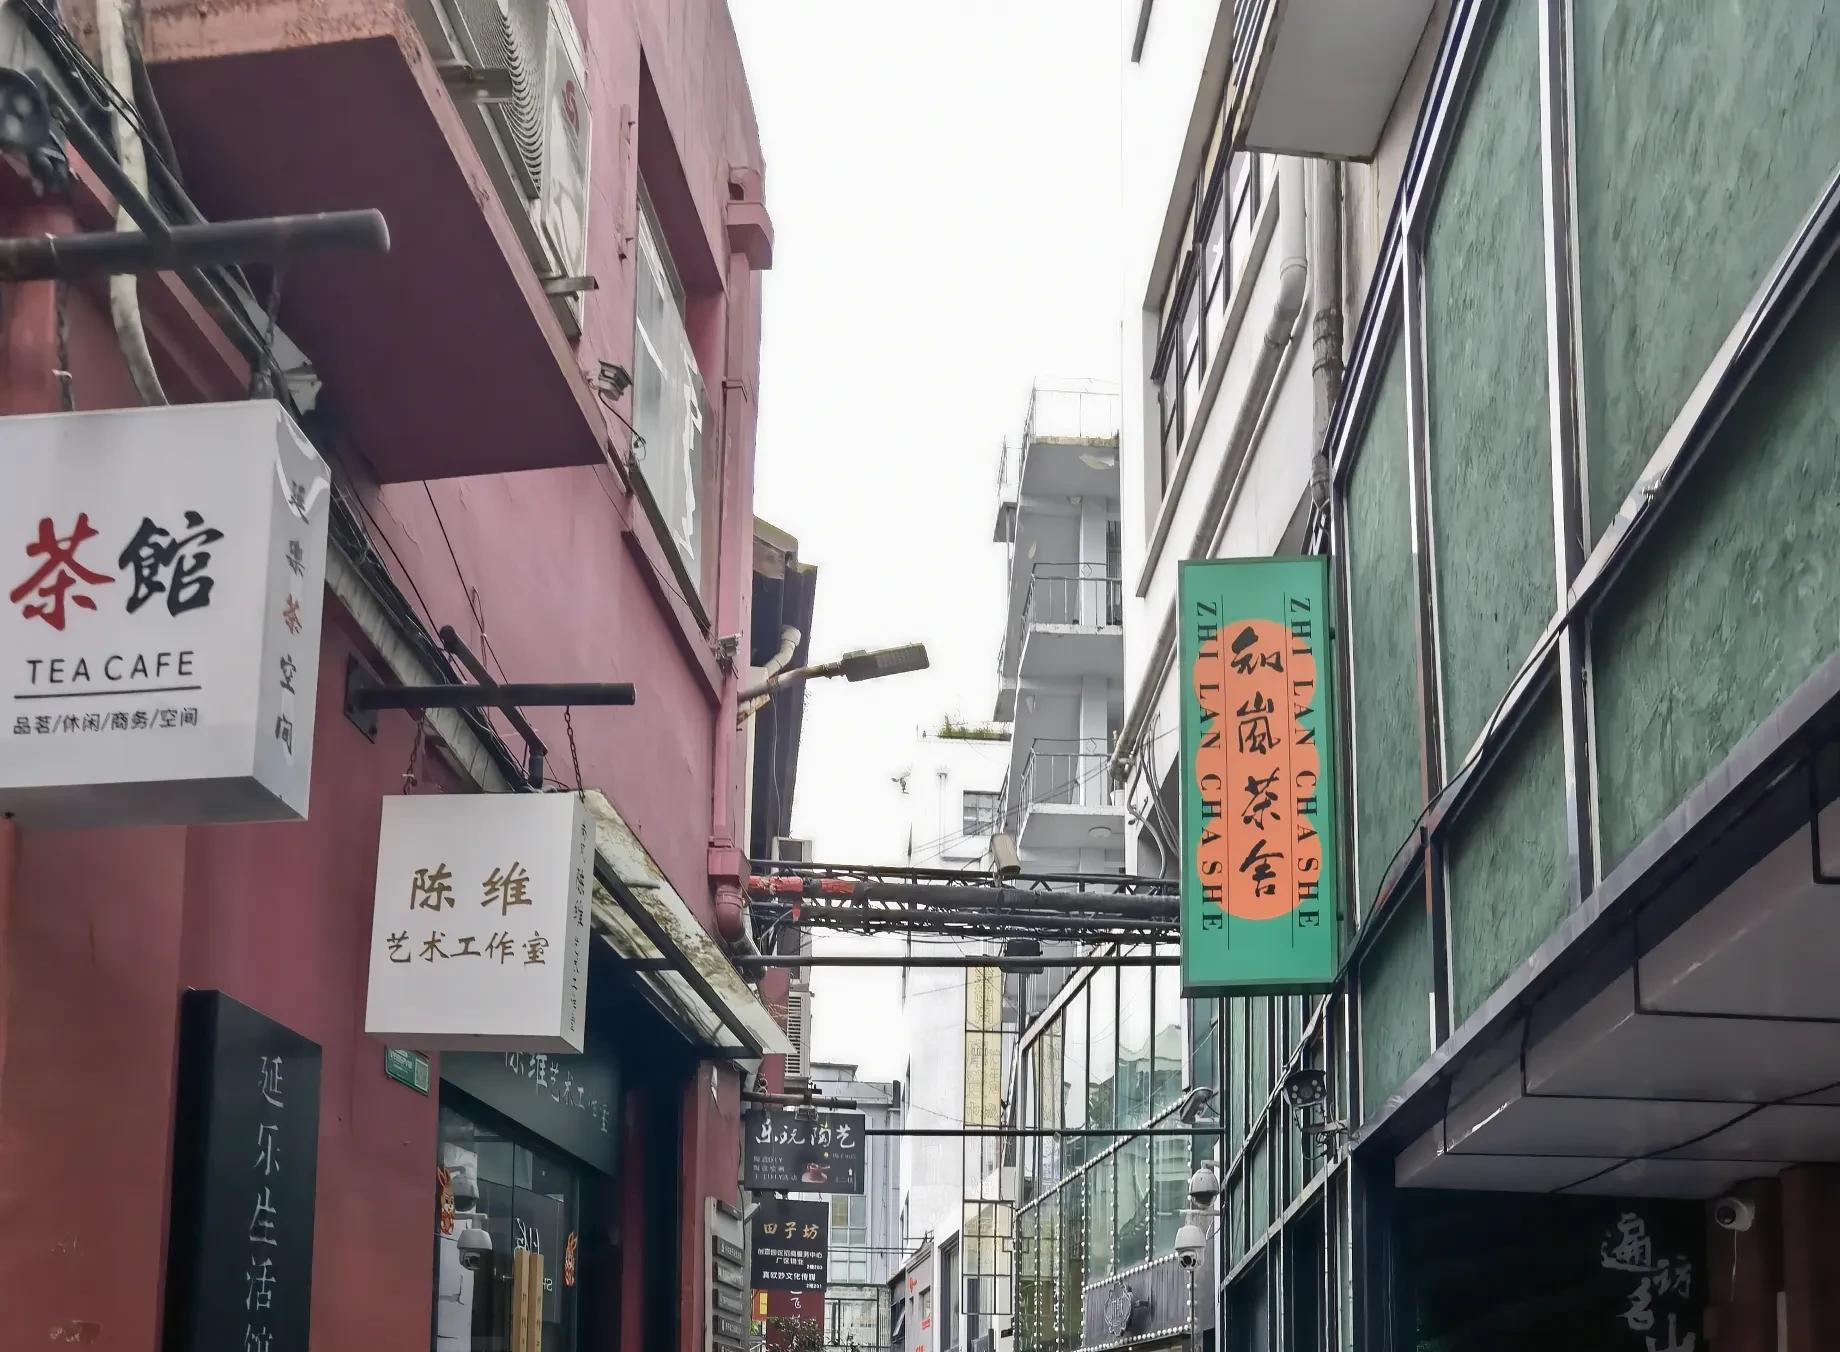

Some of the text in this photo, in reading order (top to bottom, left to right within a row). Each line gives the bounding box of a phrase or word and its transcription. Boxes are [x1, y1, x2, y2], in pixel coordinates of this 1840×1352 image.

[10, 511, 225, 631] 茶館
[26, 650, 195, 685] TEA CAFE
[13, 706, 199, 736] 品茗/休闲/商务/空间
[1197, 600, 1223, 931] ZHI LAN CHA SHE
[1289, 597, 1320, 929] ZHI LAN CHA SHE
[409, 861, 533, 917] 陈维
[386, 930, 549, 966] 艺术工作室
[763, 1221, 819, 1240] 田子坊
